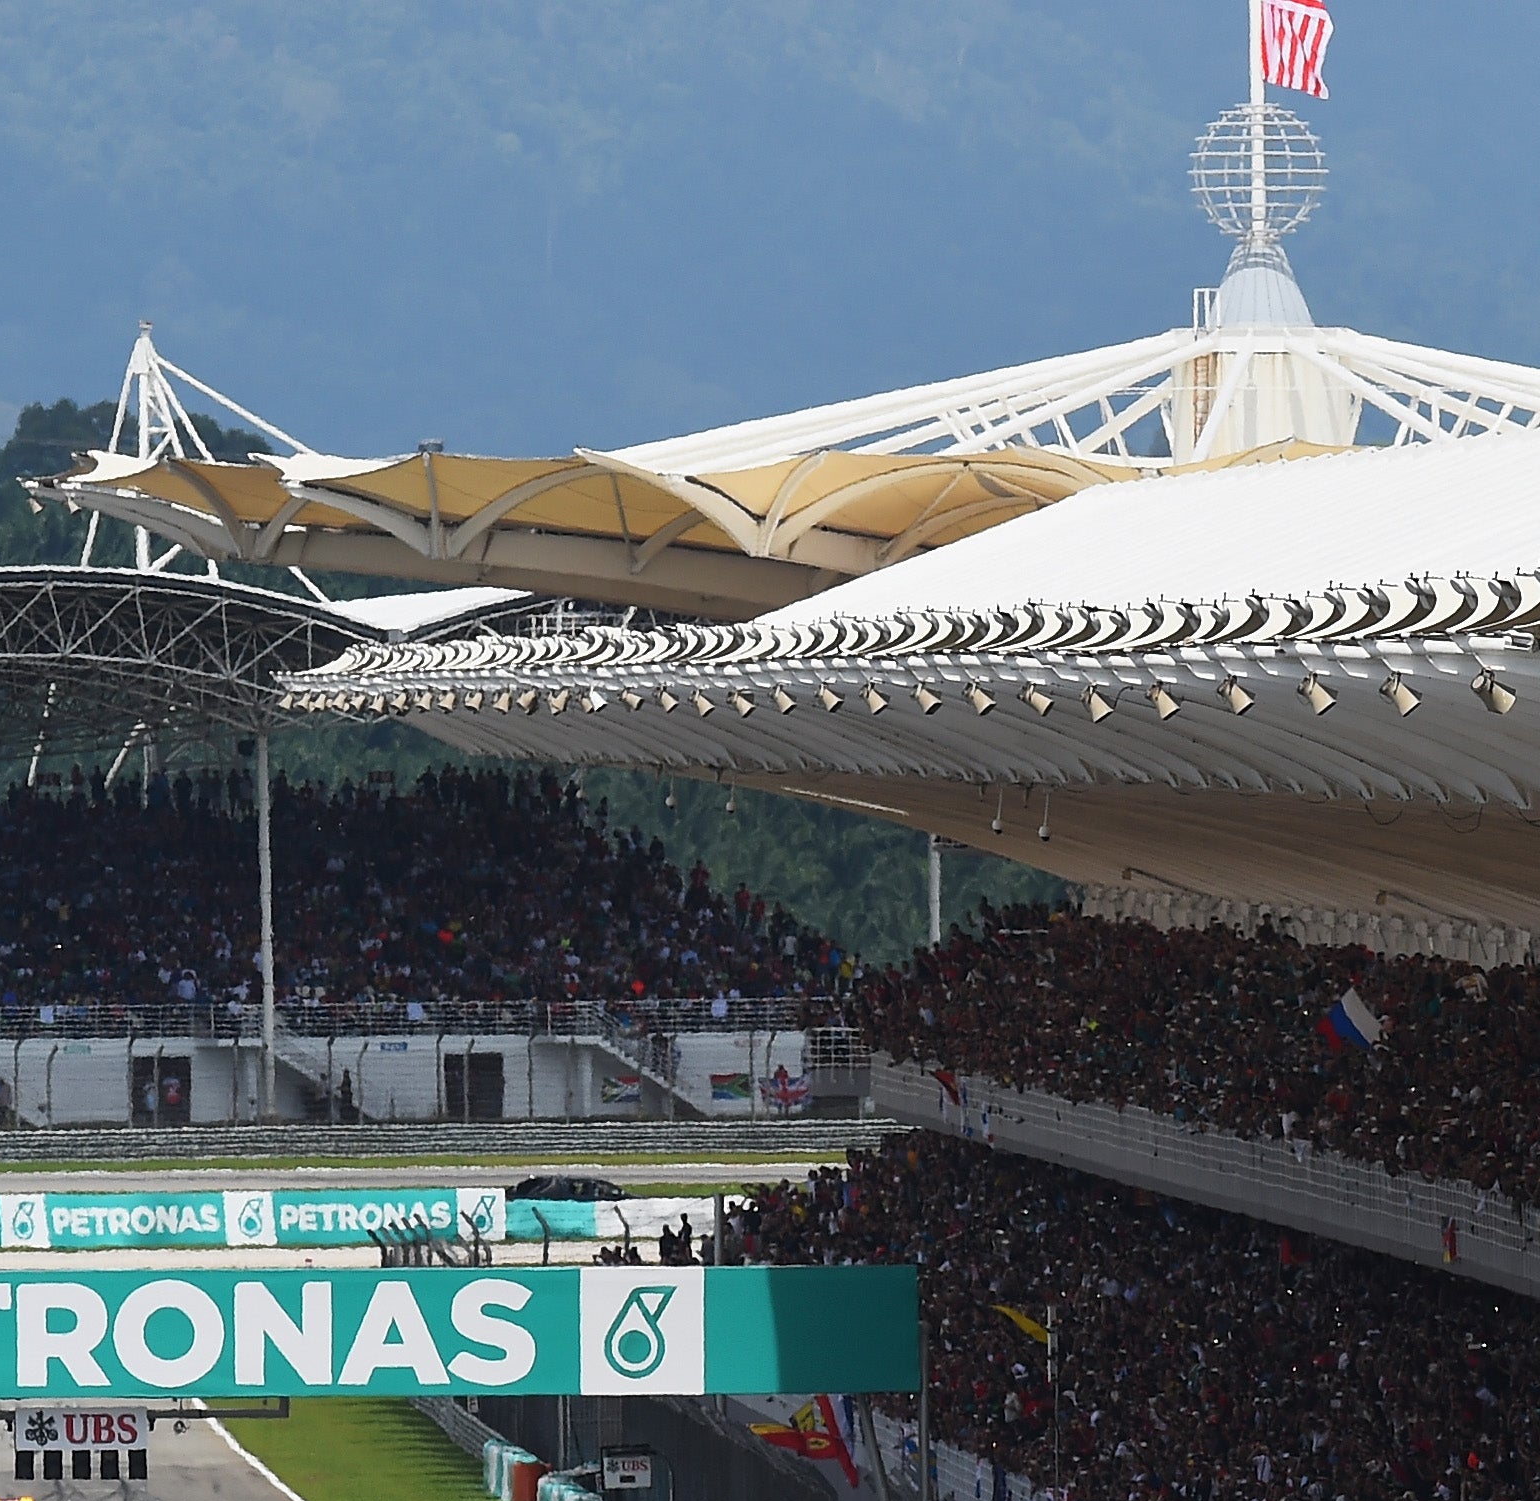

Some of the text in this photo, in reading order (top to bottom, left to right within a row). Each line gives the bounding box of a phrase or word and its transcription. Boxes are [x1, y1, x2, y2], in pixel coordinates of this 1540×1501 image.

[51, 1203, 221, 1236] PETRONAS
[279, 1201, 452, 1233] PETRONAS
[64, 1415, 139, 1445] UBS
[621, 1459, 649, 1472] UBS
